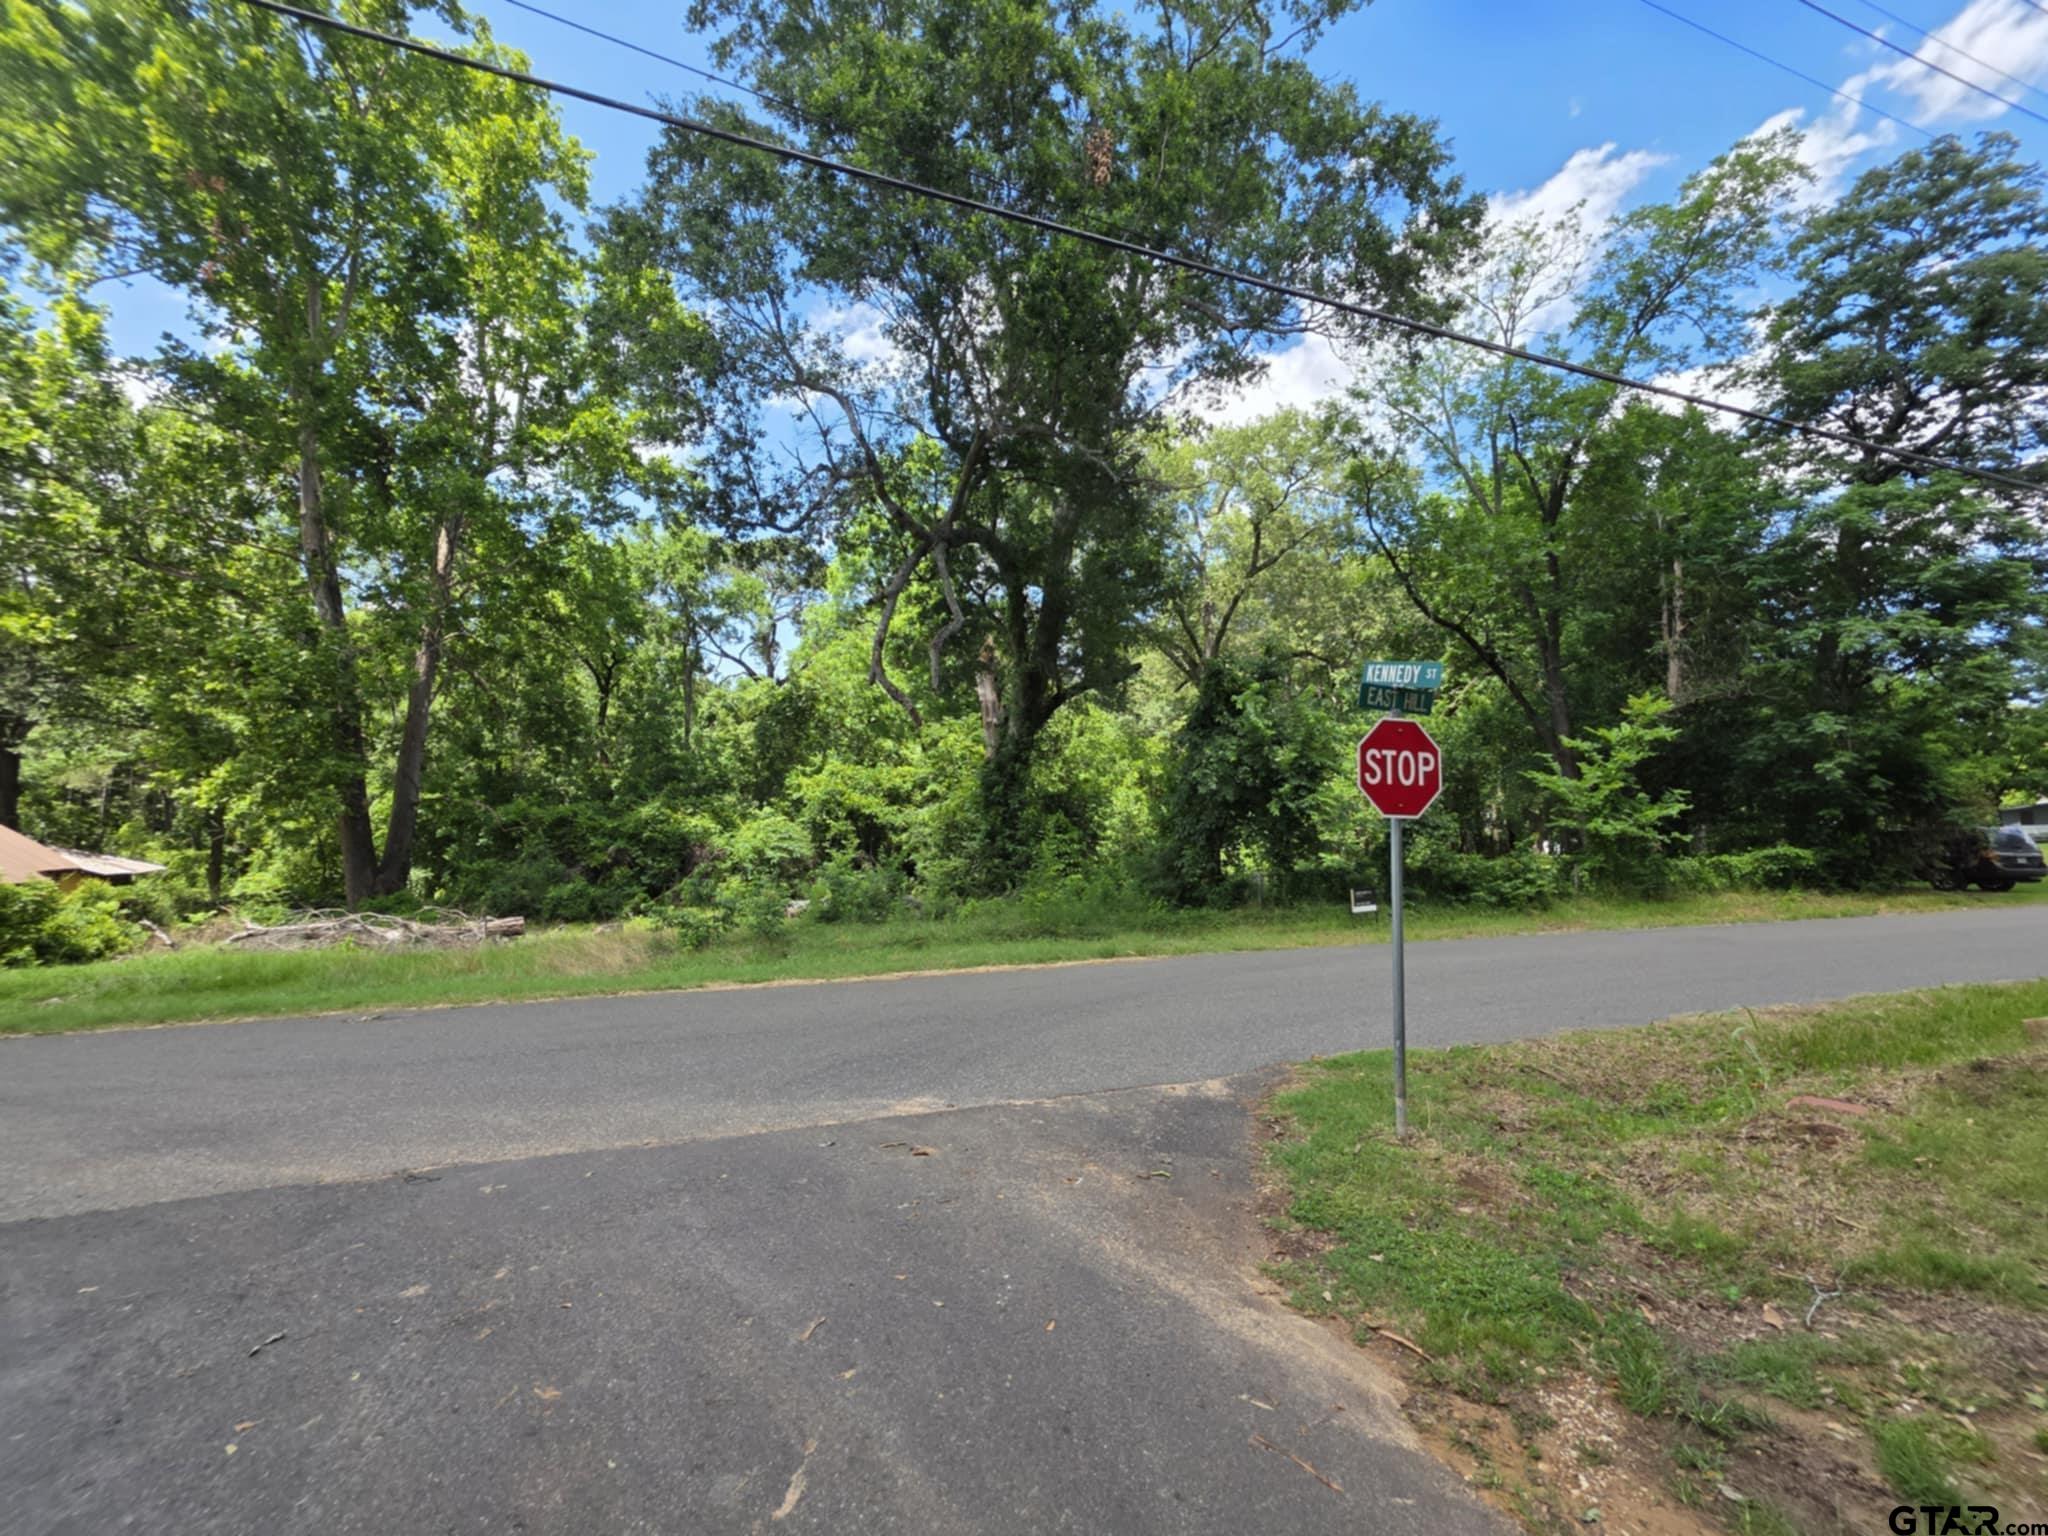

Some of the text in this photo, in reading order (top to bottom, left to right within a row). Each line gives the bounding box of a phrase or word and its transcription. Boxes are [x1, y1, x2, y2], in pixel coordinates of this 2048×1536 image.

[1366, 664, 1438, 685] KENNEDY ST
[1366, 687, 1398, 709] EAST
[1364, 748, 1435, 787] STOP
